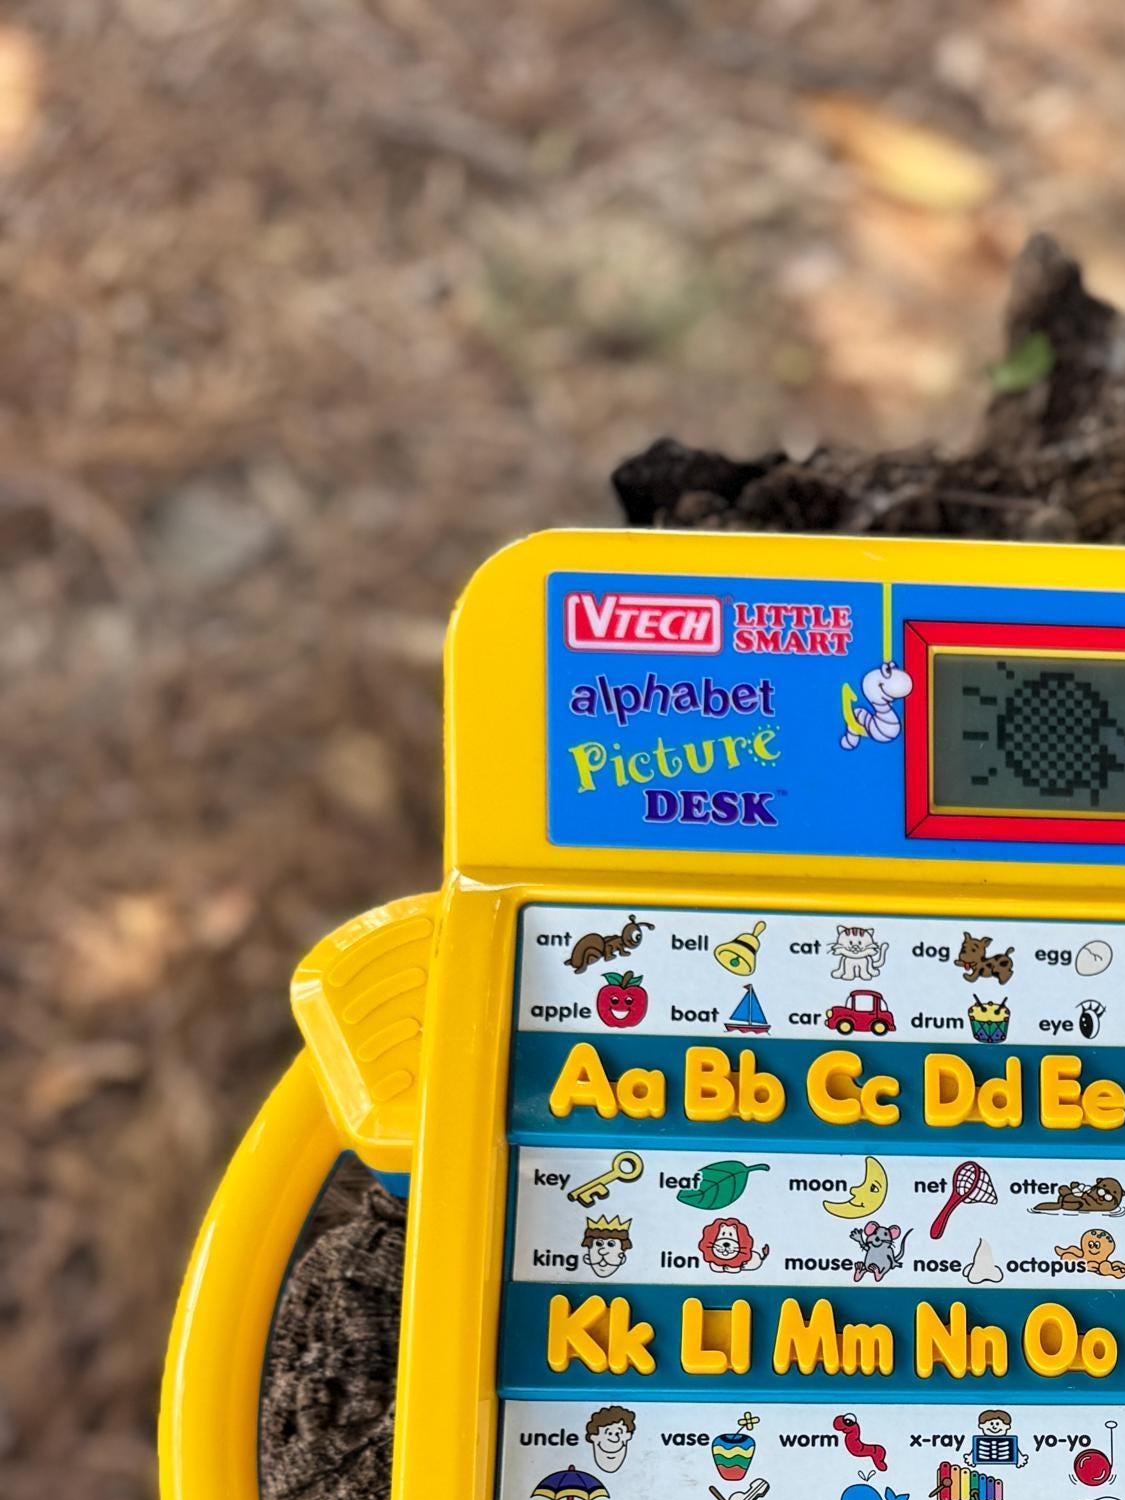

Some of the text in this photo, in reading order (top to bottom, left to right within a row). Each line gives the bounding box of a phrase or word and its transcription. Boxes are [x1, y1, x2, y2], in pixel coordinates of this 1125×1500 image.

[577, 593, 713, 642] VTECH
[734, 603, 852, 629] LITTLE
[734, 629, 852, 655] SMART
[570, 673, 775, 726] alphabet
[569, 728, 781, 793] Picture
[537, 931, 571, 948] ant
[671, 935, 709, 952] bell
[789, 940, 821, 955] cat
[912, 942, 950, 961] dog
[1035, 949, 1072, 967] egg
[531, 1003, 591, 1022] apple
[671, 1006, 719, 1023] boat
[788, 1010, 821, 1025] car
[911, 1012, 964, 1029] drum
[1039, 1018, 1073, 1035] eye
[549, 1042, 666, 1119] Aa
[683, 1046, 786, 1123] Bb
[806, 1050, 900, 1126] Cc
[923, 1053, 1022, 1128] Dd
[534, 1169, 570, 1190] key
[659, 1172, 701, 1189] leaf
[789, 1177, 848, 1192] moon
[914, 1178, 948, 1193] net
[1010, 1179, 1059, 1195] otter
[533, 1249, 578, 1271] king
[660, 1252, 699, 1268] lion
[785, 1256, 853, 1271] mouse
[913, 1258, 962, 1272] nose
[1006, 1259, 1086, 1278] octopus
[547, 1294, 656, 1374] Kk
[680, 1298, 752, 1375] Ll
[772, 1298, 895, 1376] Mm
[915, 1301, 1009, 1379] Nn
[1022, 1302, 1118, 1378] Oo
[520, 1429, 579, 1446] uncle
[661, 1433, 710, 1447] vase
[779, 1433, 839, 1448] worm
[909, 1431, 965, 1451] x-ray
[1033, 1433, 1091, 1451] yo-yo
